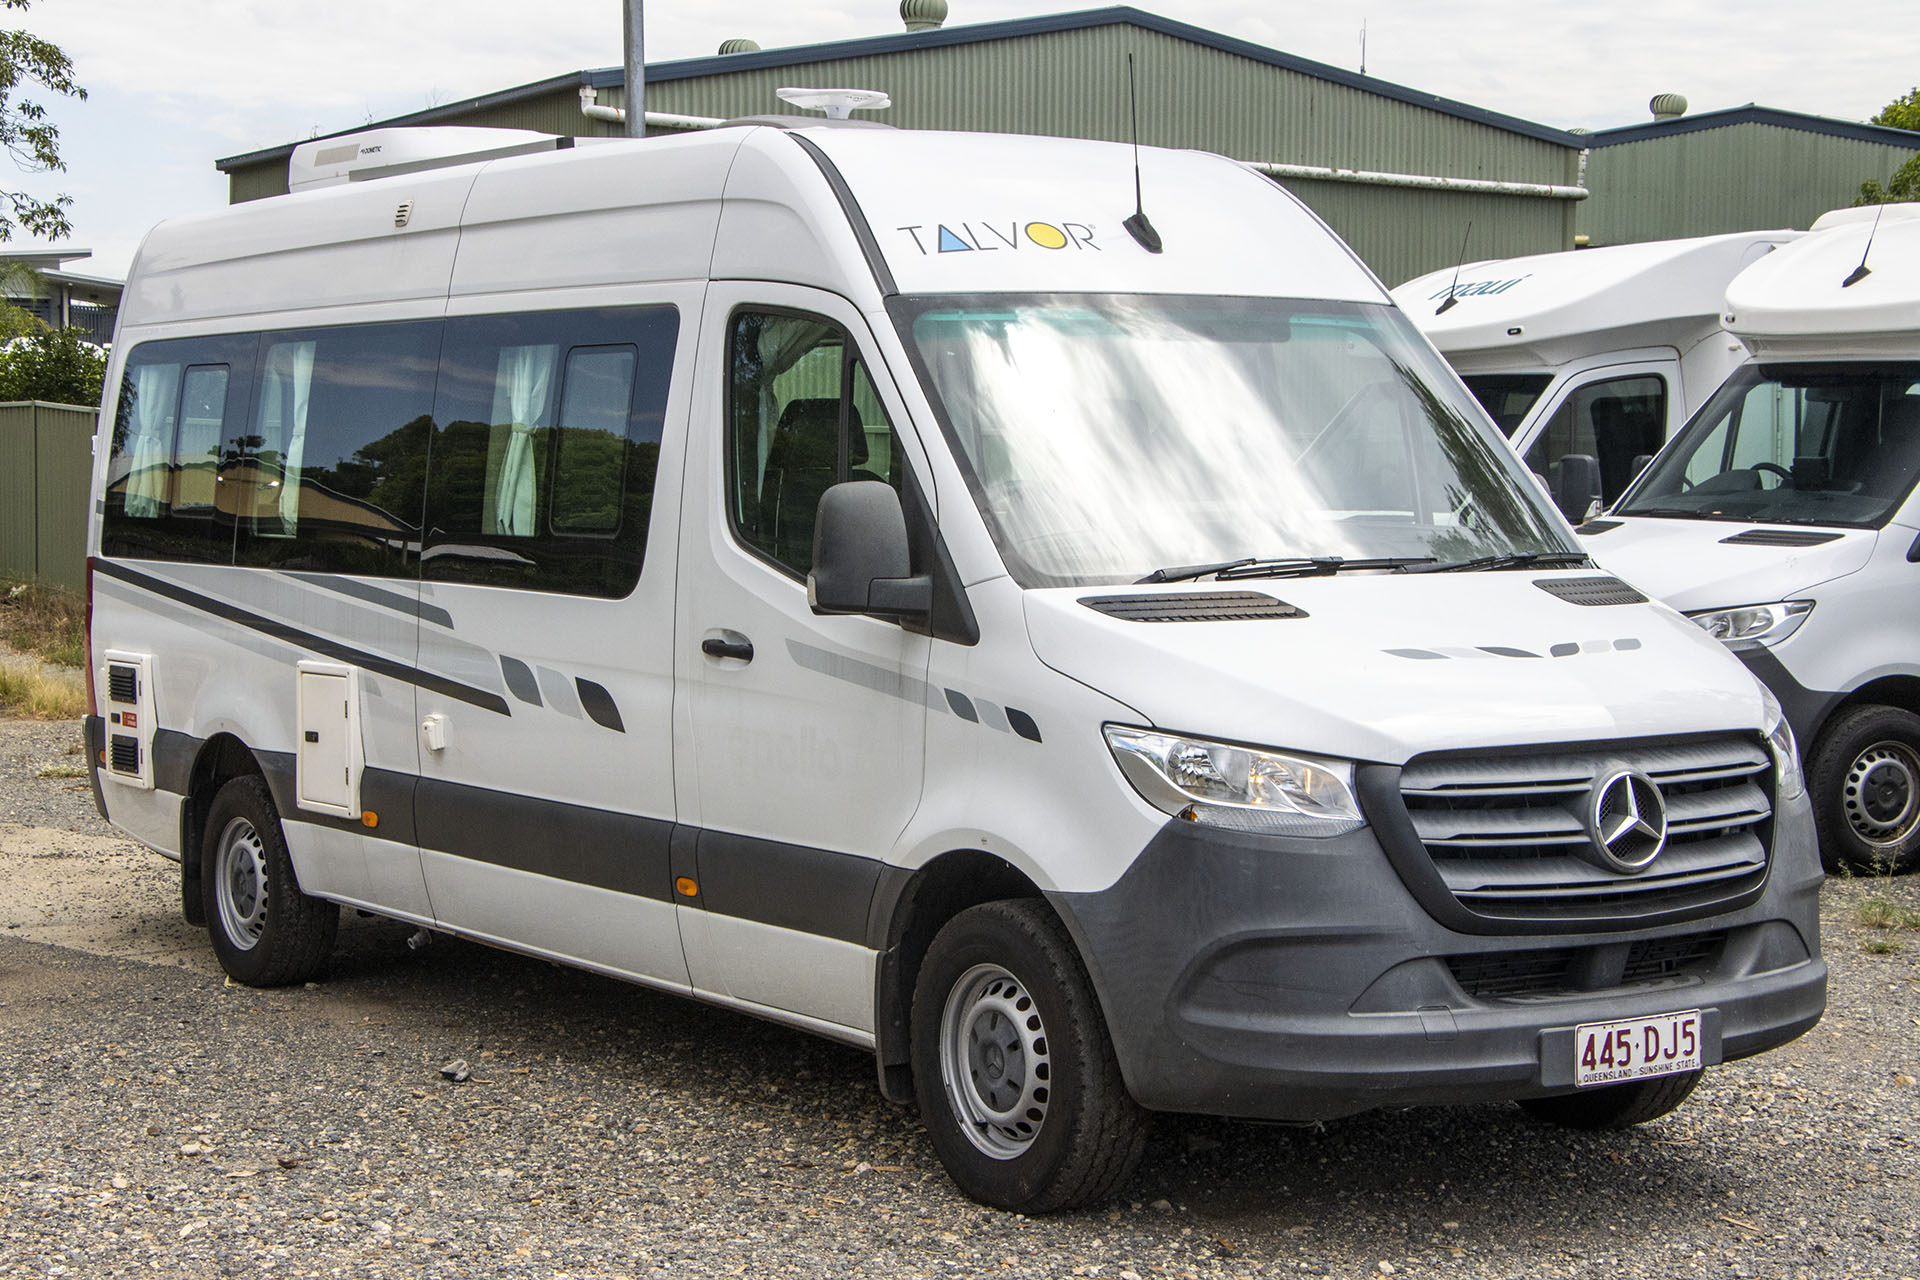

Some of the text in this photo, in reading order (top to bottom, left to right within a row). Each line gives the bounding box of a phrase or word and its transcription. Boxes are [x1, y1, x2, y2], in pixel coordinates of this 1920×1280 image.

[897, 222, 1101, 255] TALVOR
[1583, 1069, 1632, 1083] QUEENSLAND
[1640, 1062, 1673, 1076] SUNSHINE
[1677, 1059, 1696, 1070] STATE
